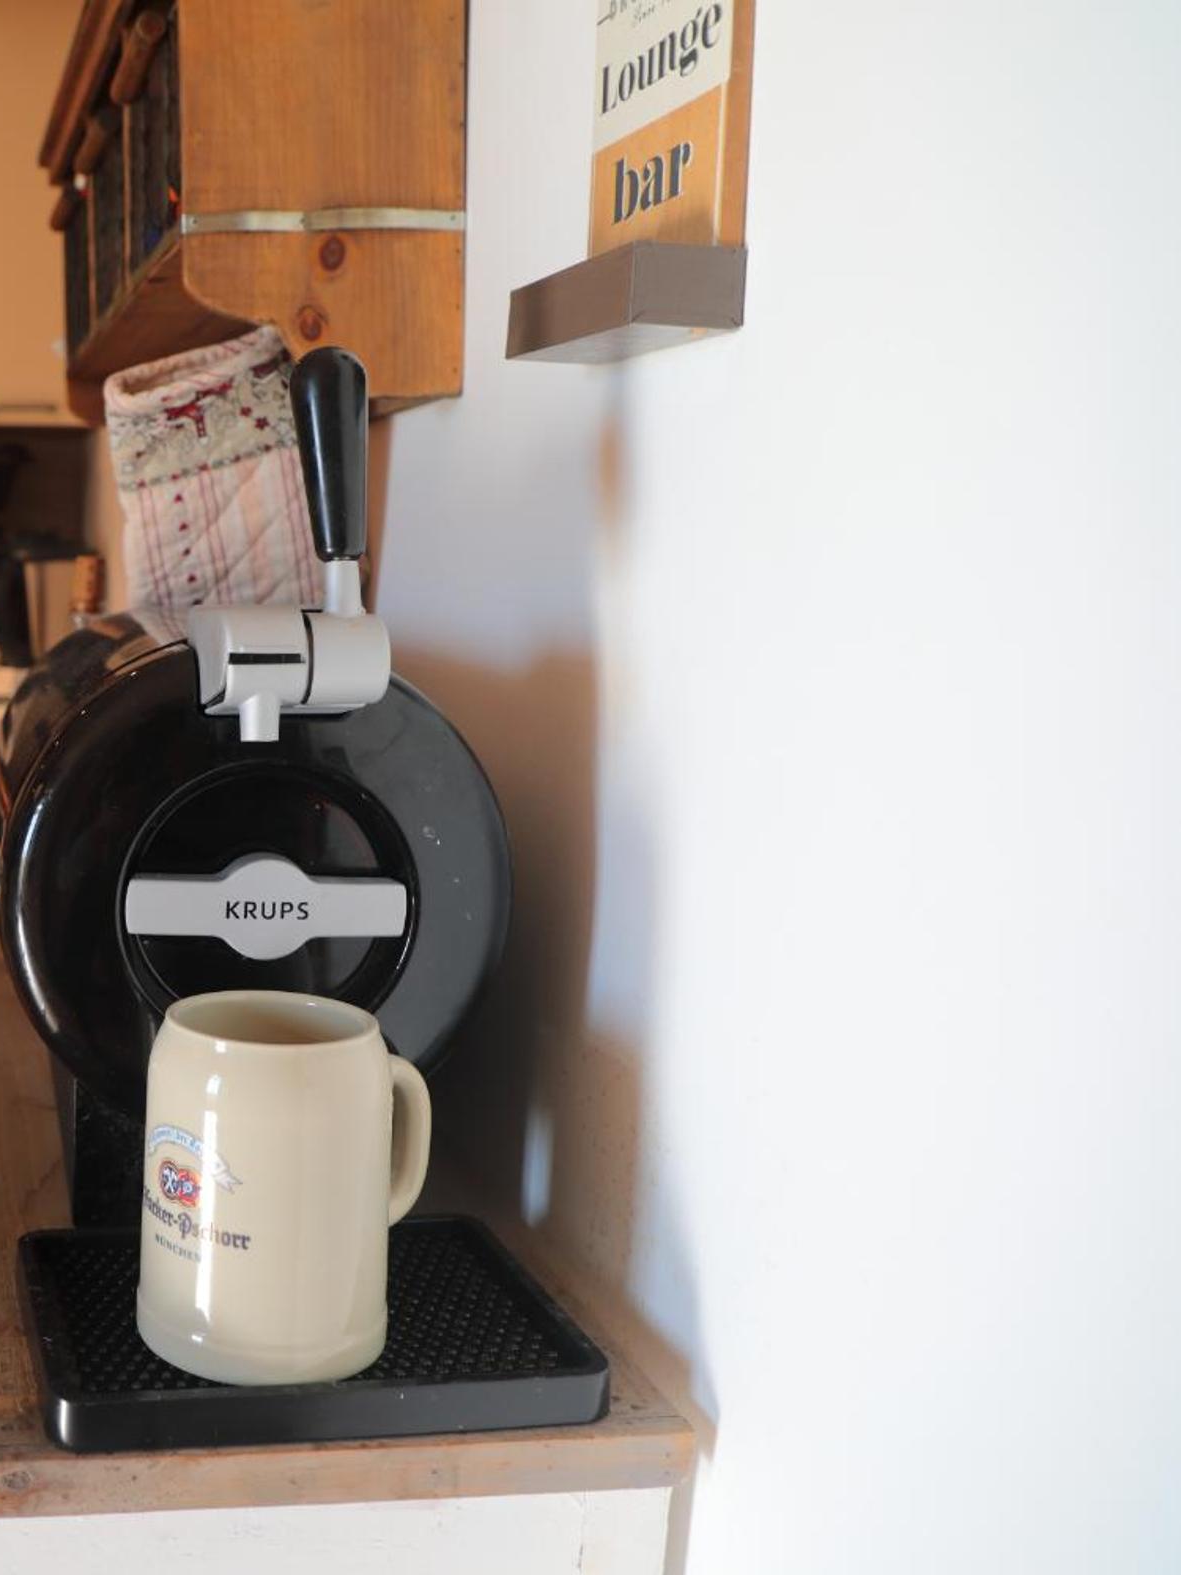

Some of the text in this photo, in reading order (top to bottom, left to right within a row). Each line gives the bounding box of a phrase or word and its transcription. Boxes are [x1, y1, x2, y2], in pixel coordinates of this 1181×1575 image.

[601, 4, 722, 115] Lounge
[612, 141, 692, 225] bar
[226, 901, 309, 920] KRUPS
